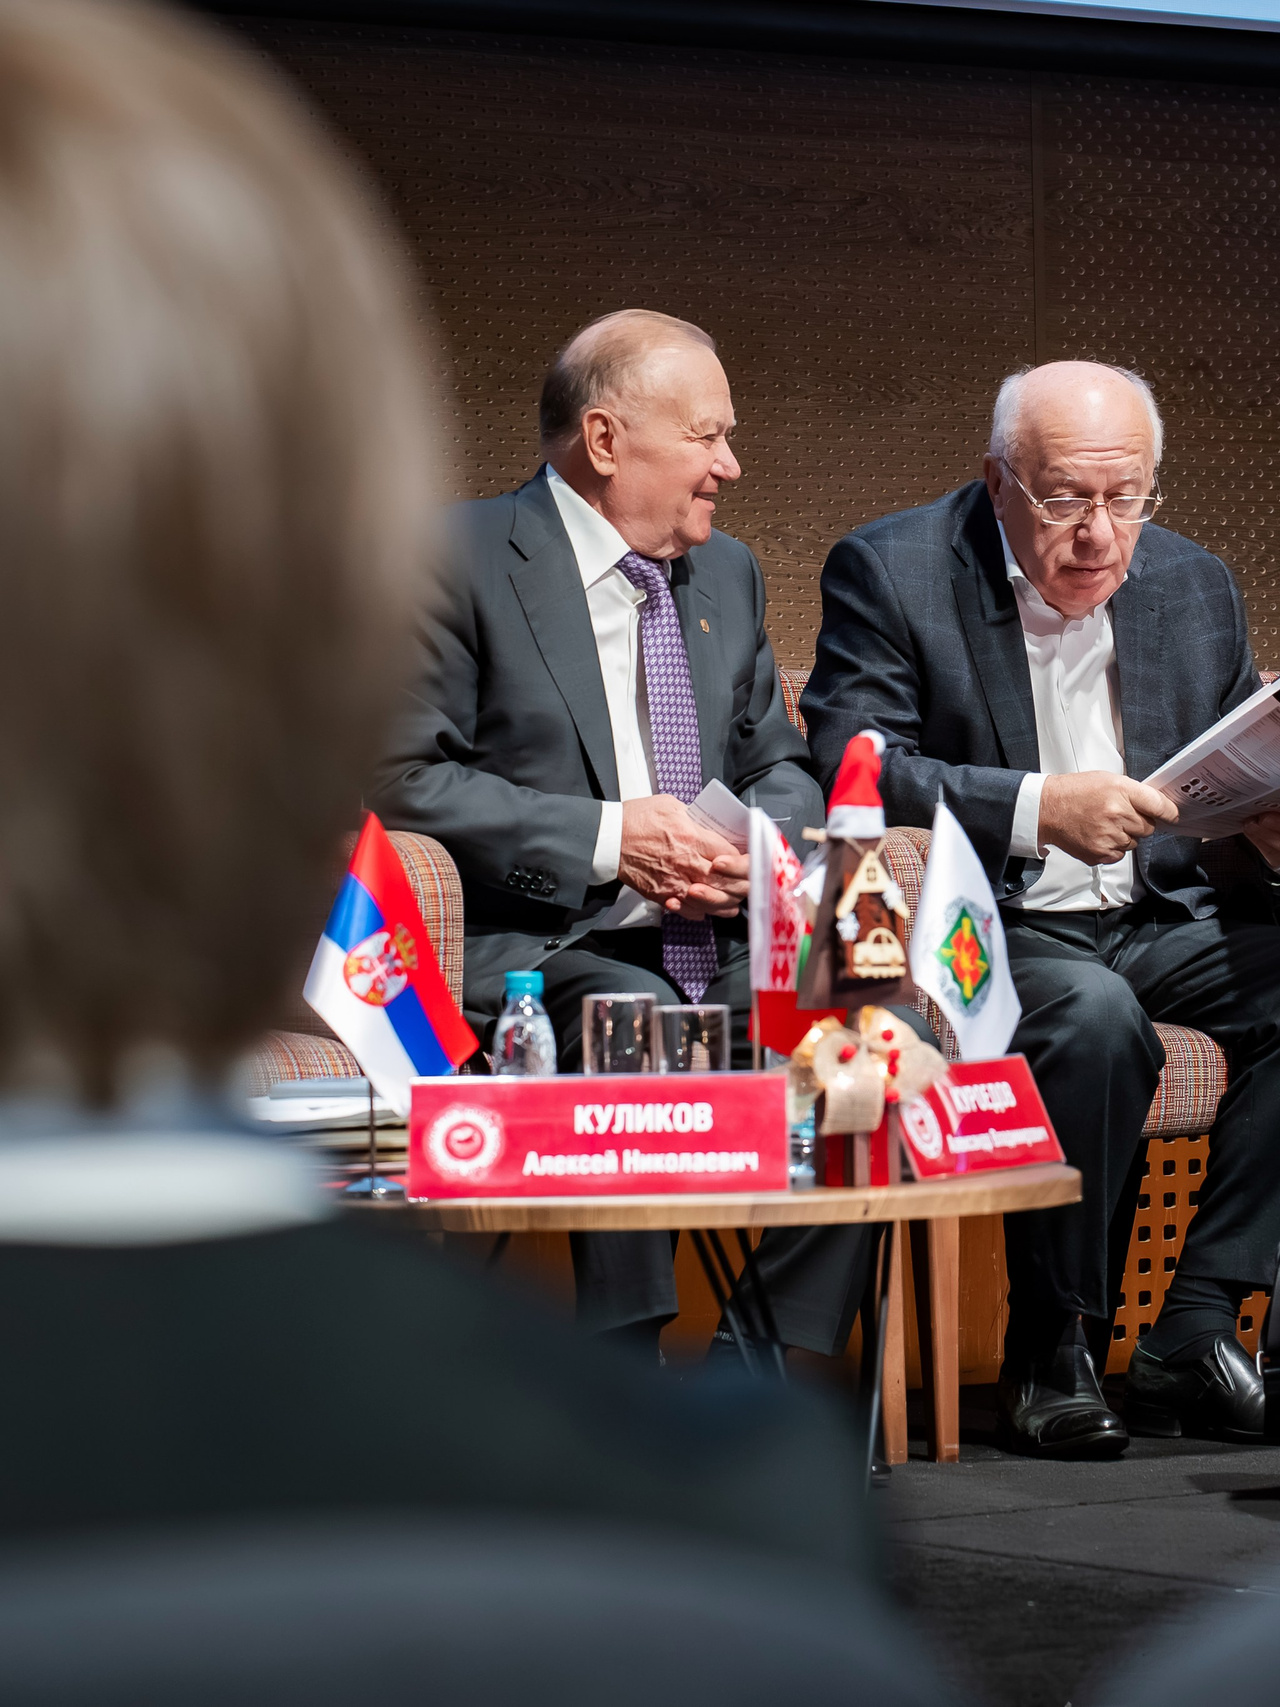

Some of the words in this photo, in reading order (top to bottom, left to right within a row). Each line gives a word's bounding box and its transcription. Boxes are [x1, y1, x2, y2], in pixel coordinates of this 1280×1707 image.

[574, 1102, 714, 1135] КУЛИКОВ
[522, 1149, 618, 1176] Алексей
[622, 1148, 760, 1174] Николаевич
